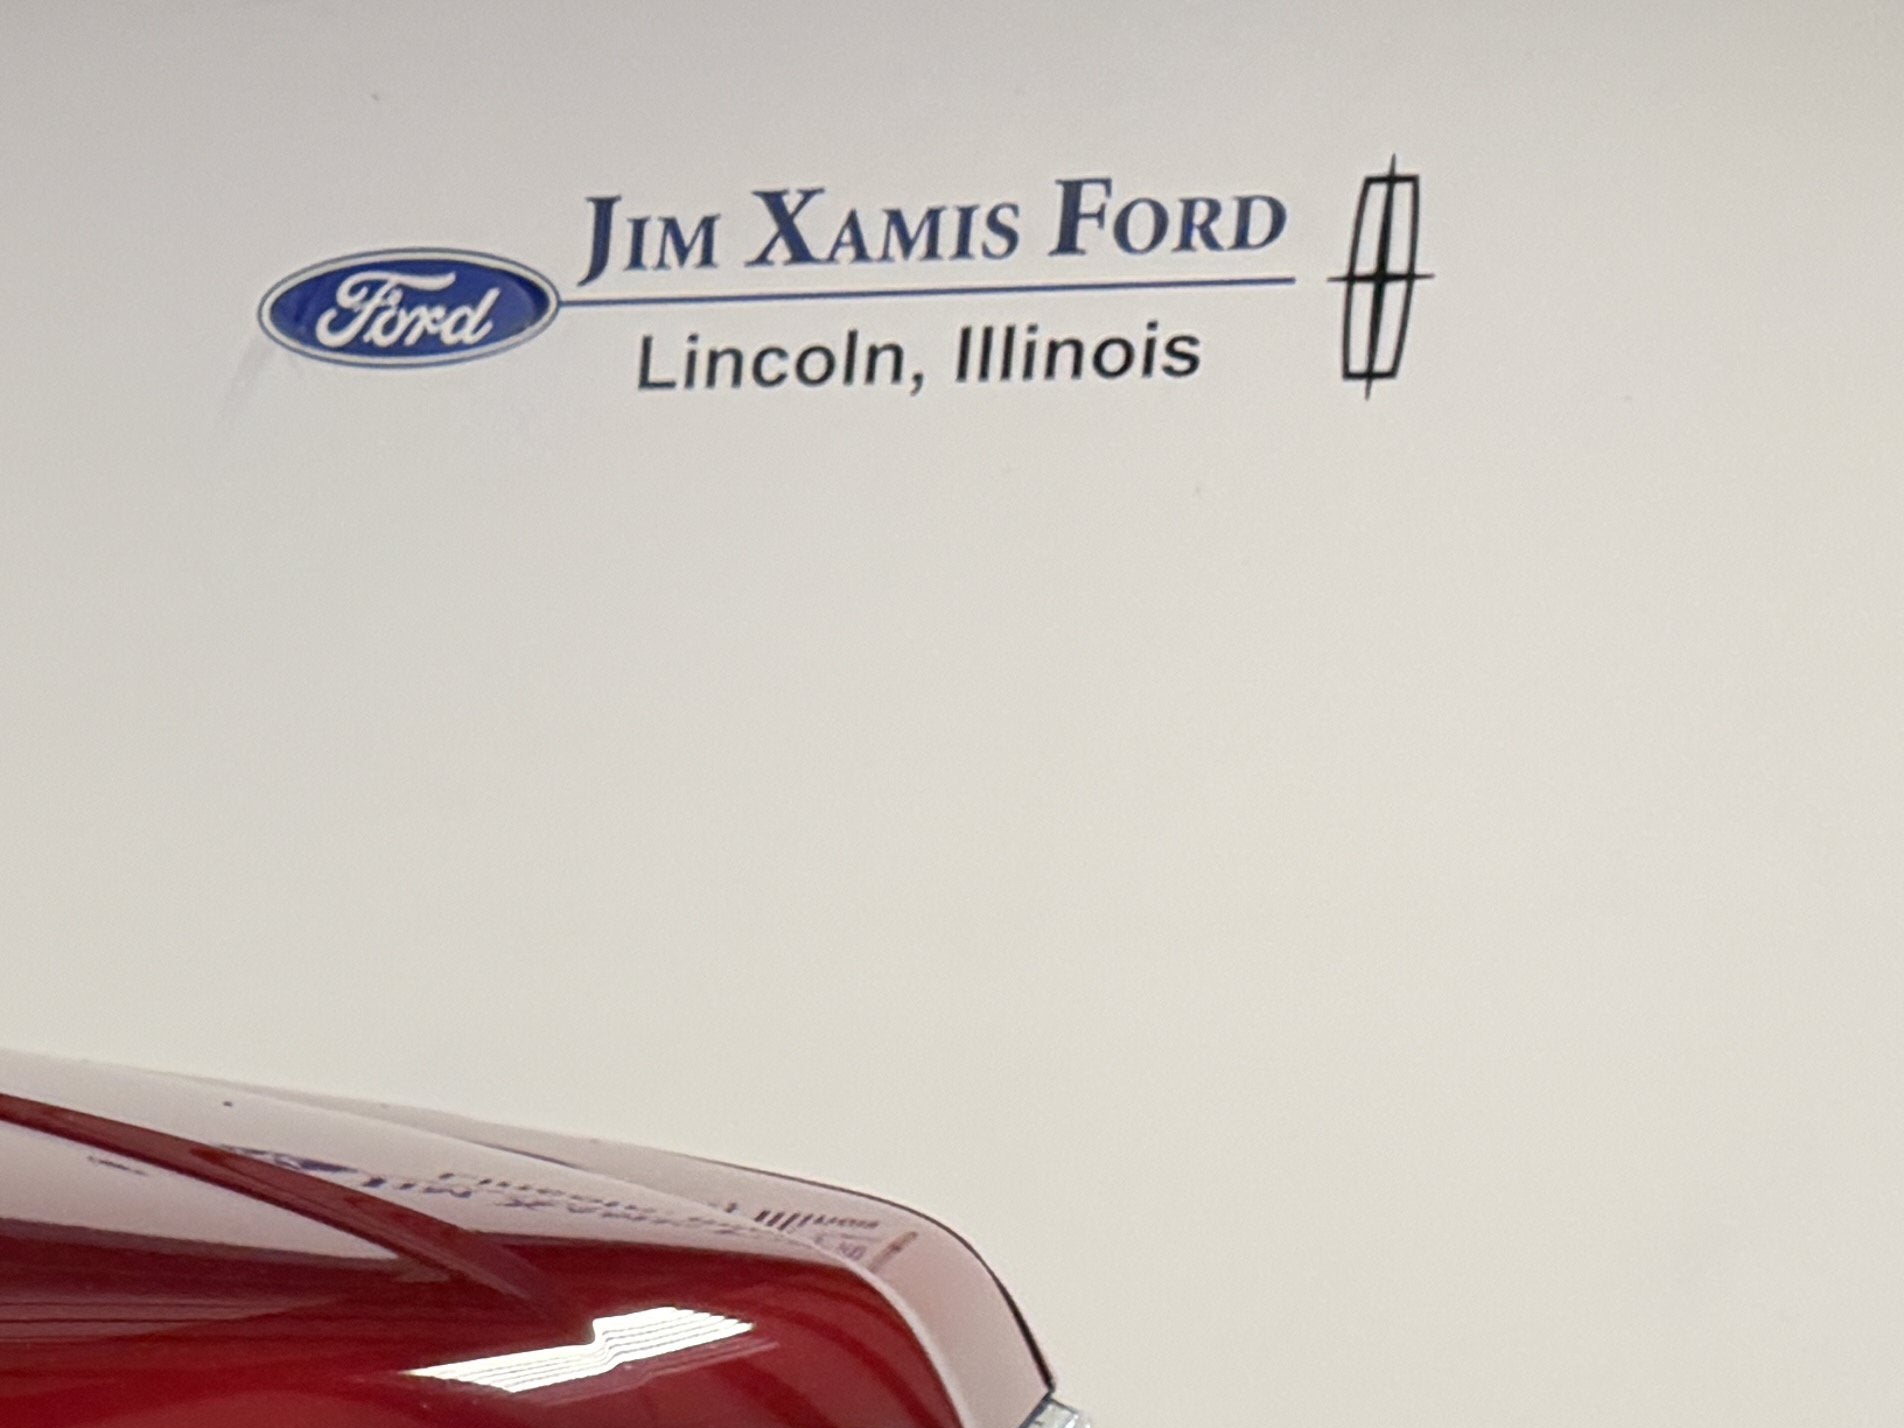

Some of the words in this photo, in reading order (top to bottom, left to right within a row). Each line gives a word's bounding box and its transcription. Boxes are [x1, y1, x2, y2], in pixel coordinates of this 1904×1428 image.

[576, 194, 722, 287] JIM
[744, 187, 1020, 268] XAMIS
[1048, 177, 1288, 257] FORD
[315, 270, 500, 347] Ford
[636, 329, 925, 397] Lincoln,
[954, 320, 1201, 383] Illinois
